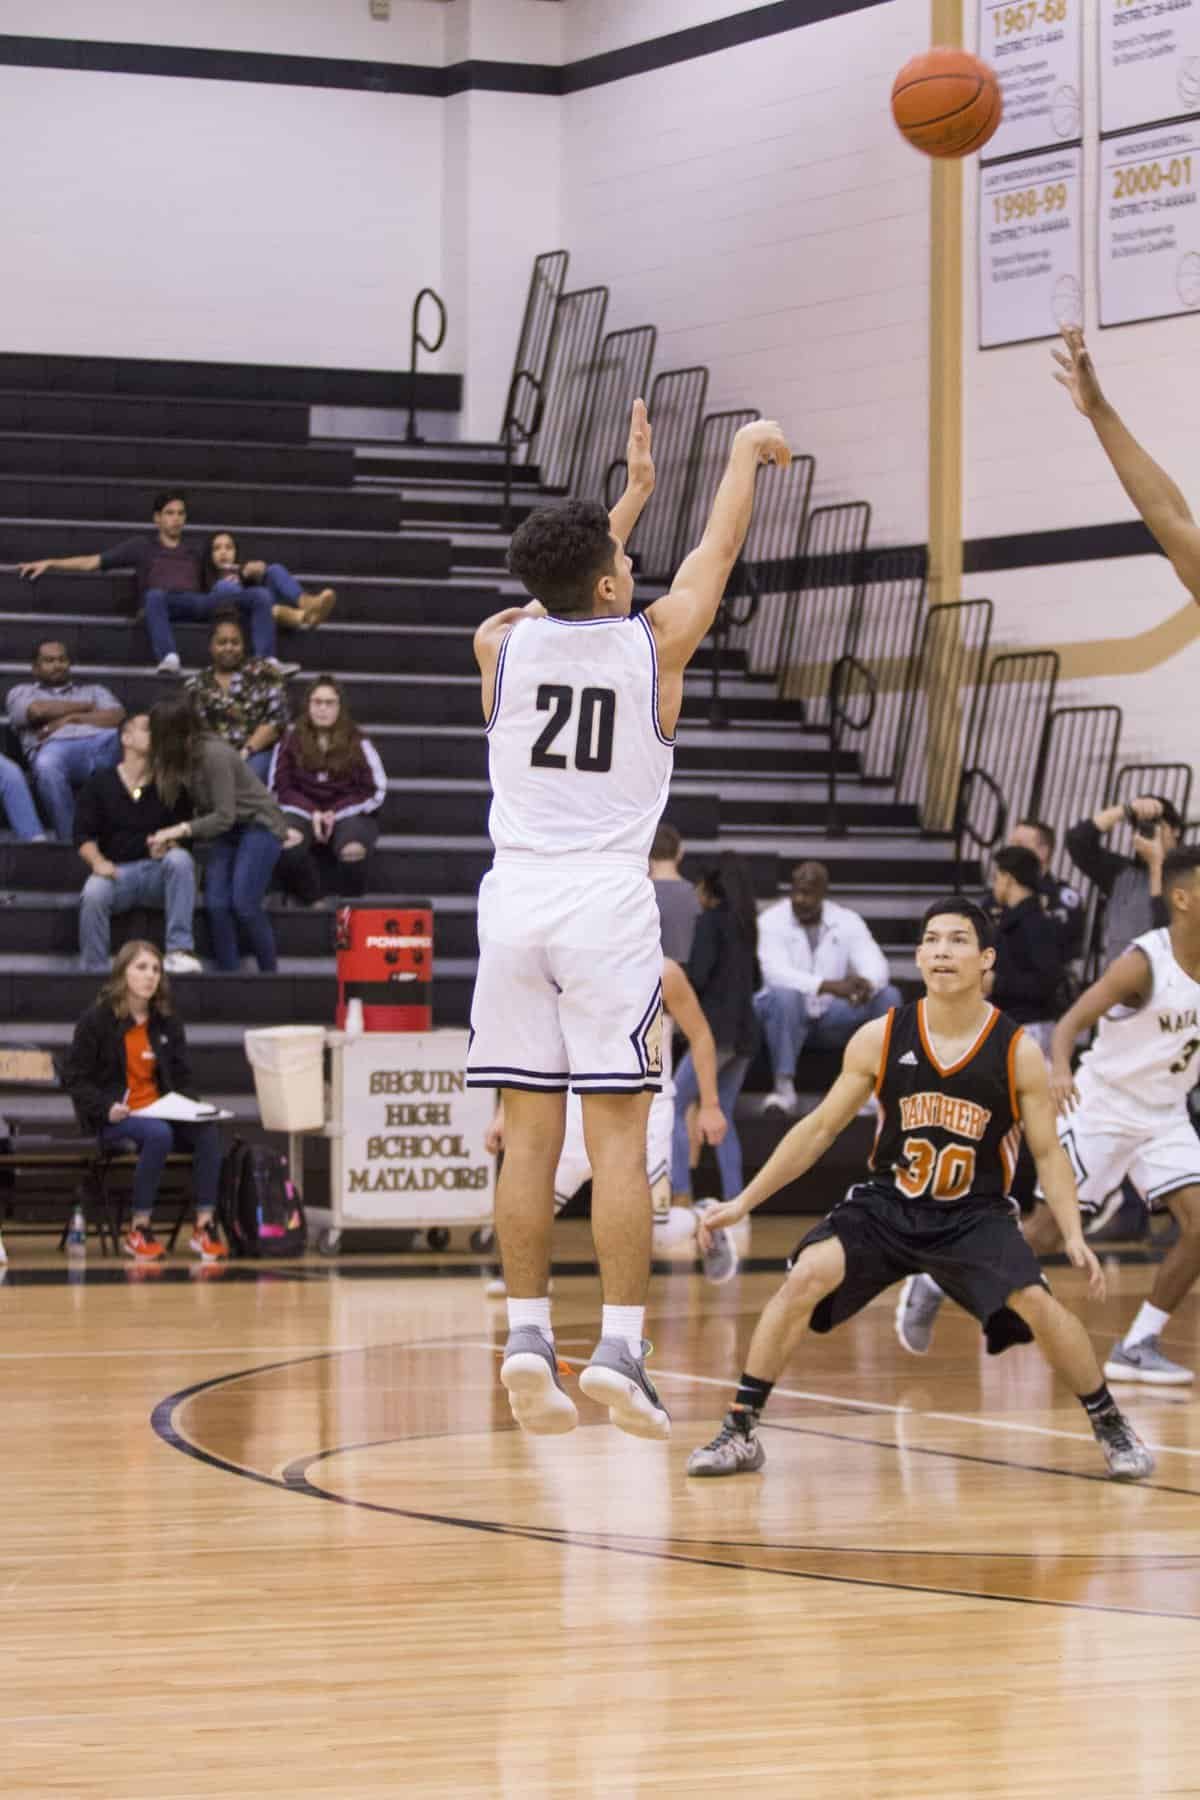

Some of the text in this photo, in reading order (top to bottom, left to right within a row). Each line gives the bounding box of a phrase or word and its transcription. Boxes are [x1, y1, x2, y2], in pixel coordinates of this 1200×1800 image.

[1112, 156, 1192, 199] 2000-01
[992, 183, 1067, 224] 1998-99
[531, 684, 616, 772] 20
[369, 1071, 464, 1095] SEGUIN
[384, 1103, 451, 1127] HIGH
[367, 1134, 470, 1160] SCHOOL
[348, 1165, 489, 1192] MATADORS
[891, 1137, 976, 1201] 30
